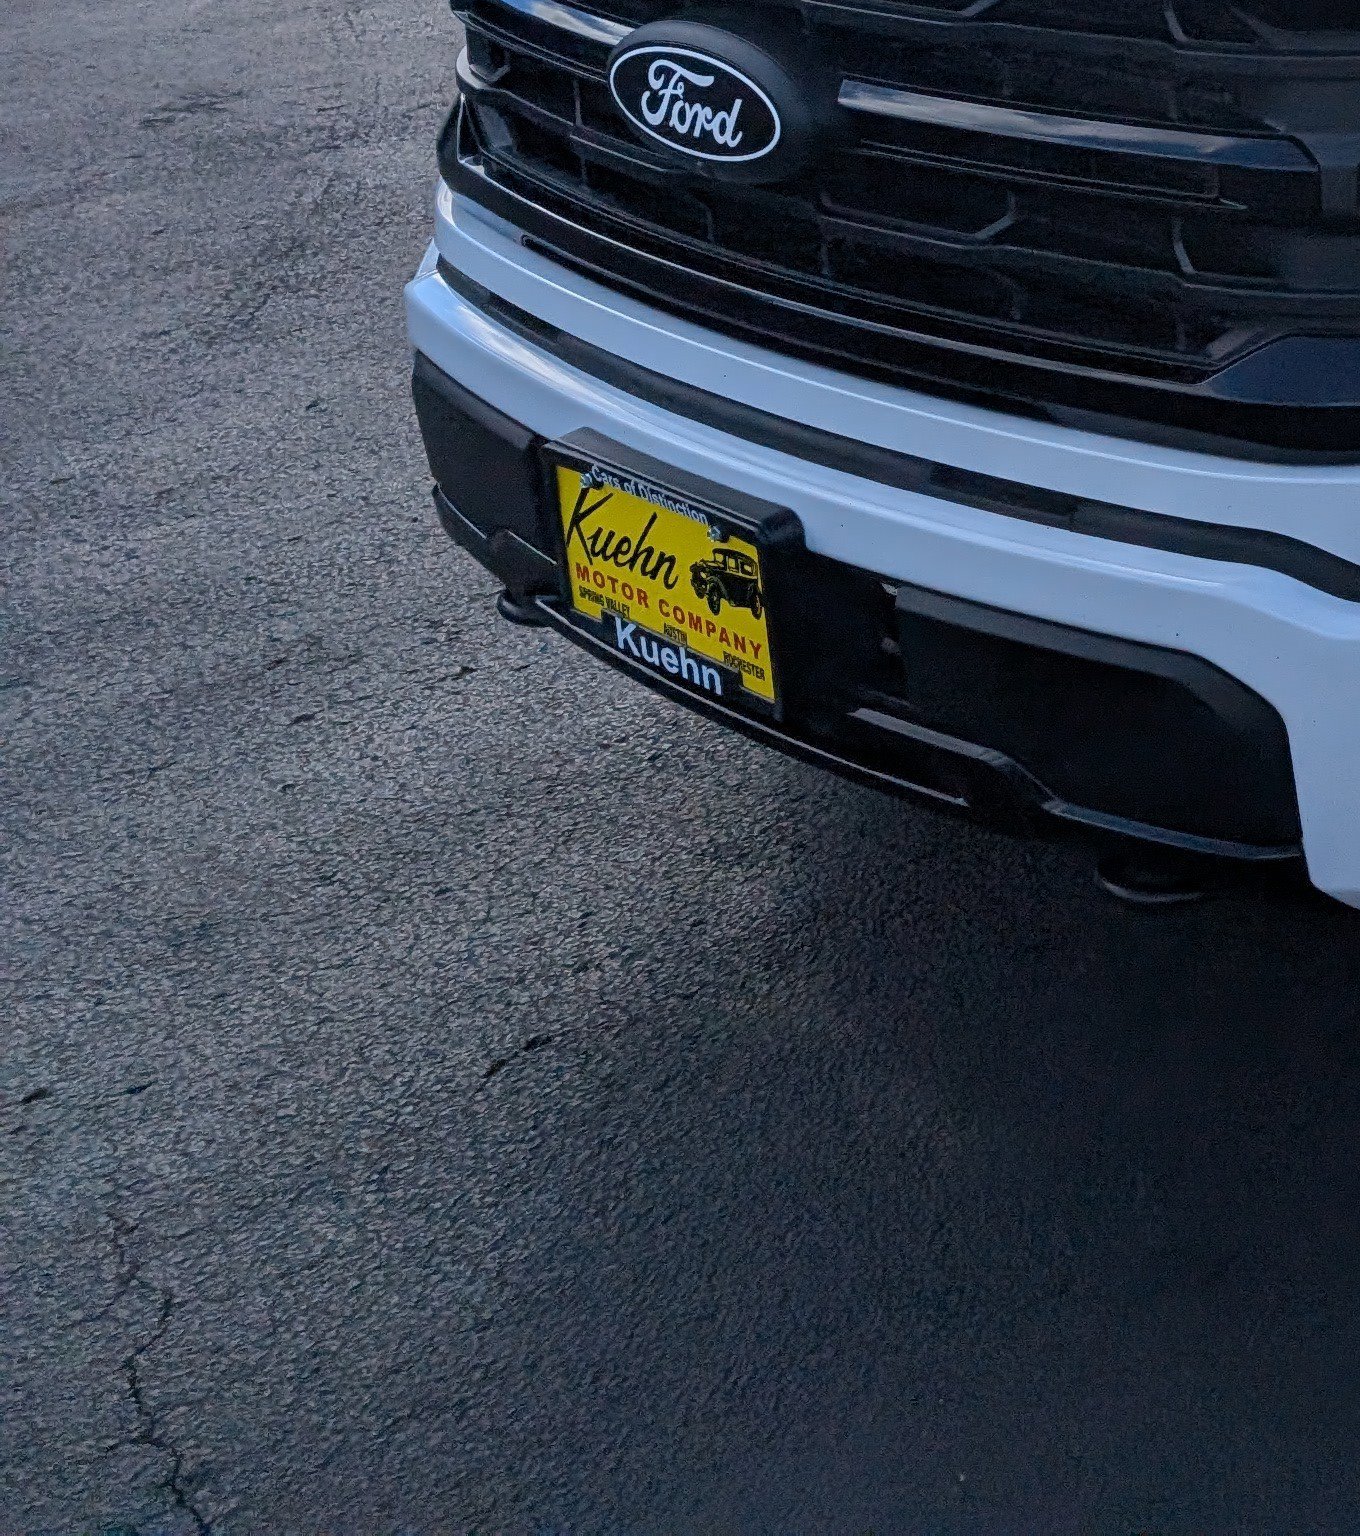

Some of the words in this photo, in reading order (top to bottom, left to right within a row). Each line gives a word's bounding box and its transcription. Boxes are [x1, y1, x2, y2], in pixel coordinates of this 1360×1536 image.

[640, 59, 744, 148] Ford
[565, 488, 679, 590] Kuehn
[591, 463, 621, 489] Cars
[623, 478, 637, 497] of
[638, 483, 709, 527] Distinction
[575, 561, 650, 609] MOTOR
[658, 598, 762, 660] COMPANY
[613, 615, 724, 696] Kuehn
